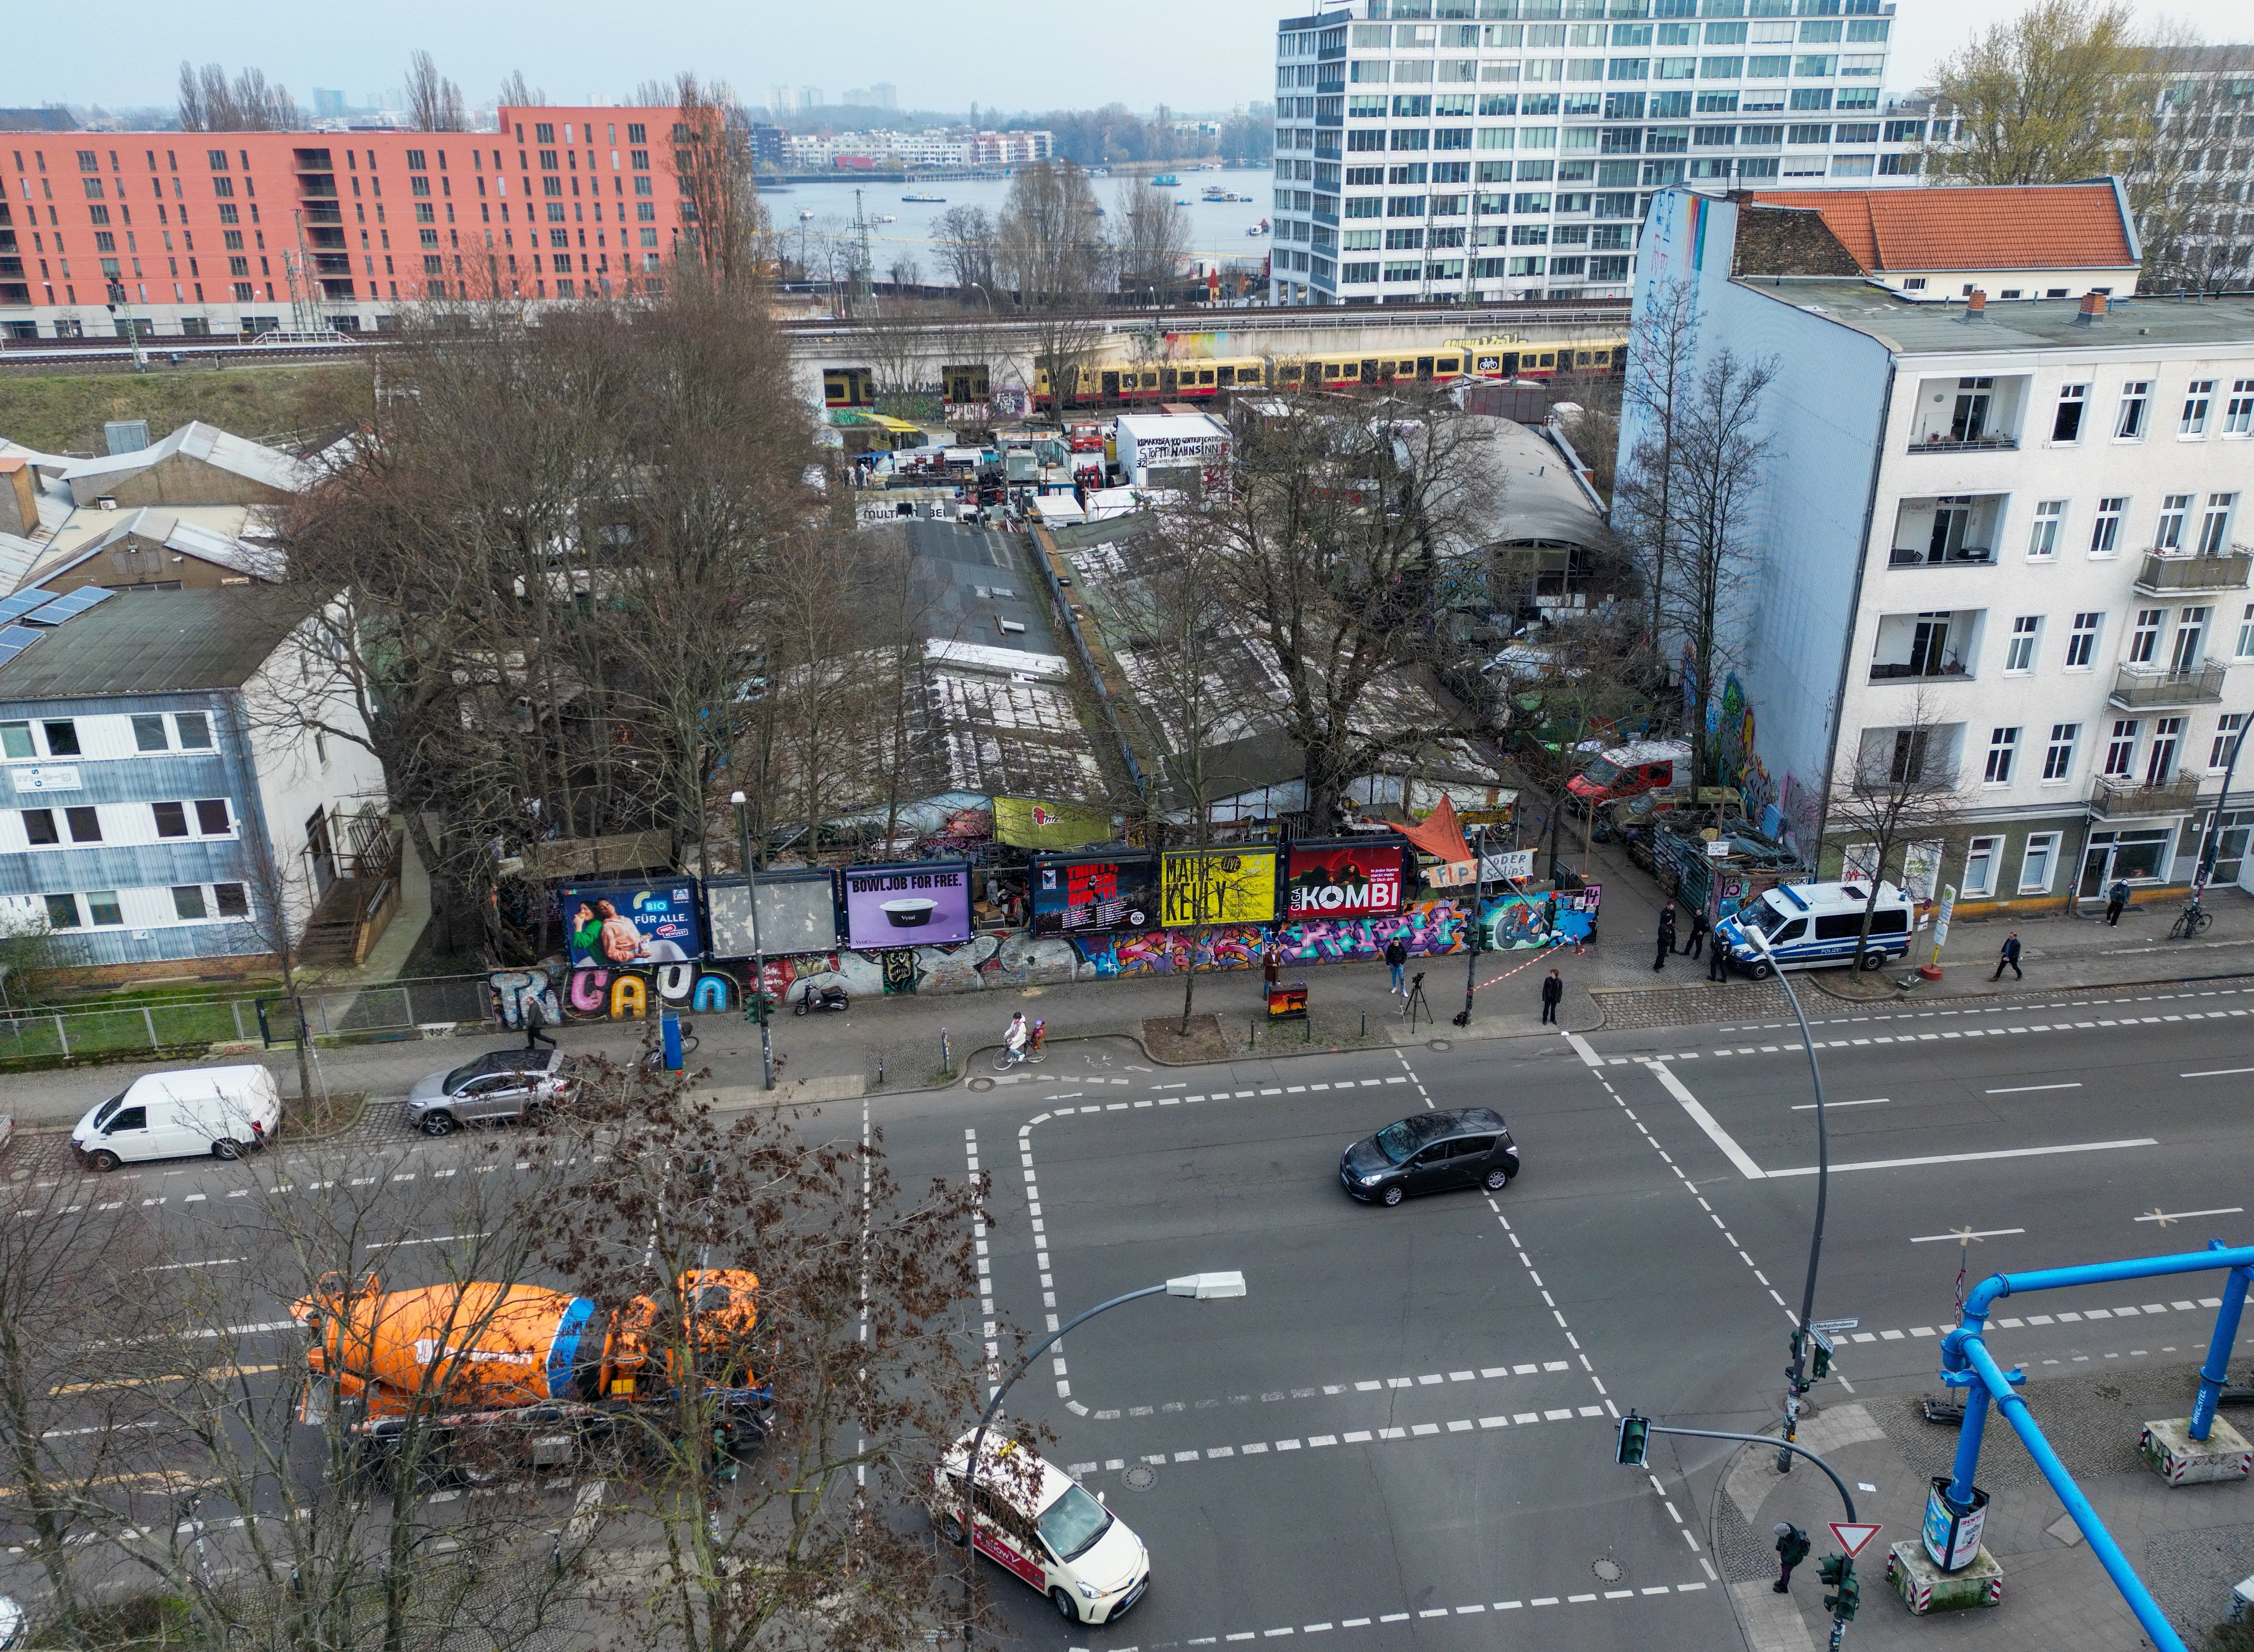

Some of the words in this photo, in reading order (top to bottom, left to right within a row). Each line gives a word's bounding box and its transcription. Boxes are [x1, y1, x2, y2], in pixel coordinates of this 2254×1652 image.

[1493, 855, 1526, 865] ODER
[852, 877, 907, 892] BOWLJOB
[912, 876, 931, 889] FOR
[934, 874, 962, 887] FREE.
[1166, 881, 1226, 920] KELLY
[1290, 888, 1301, 911] GIGA
[1301, 882, 1398, 911] KOMBI
[1584, 889, 1598, 904] 14
[647, 902, 665, 911] BIO
[635, 914, 656, 924] FÜR
[659, 914, 688, 923] ALLE.
